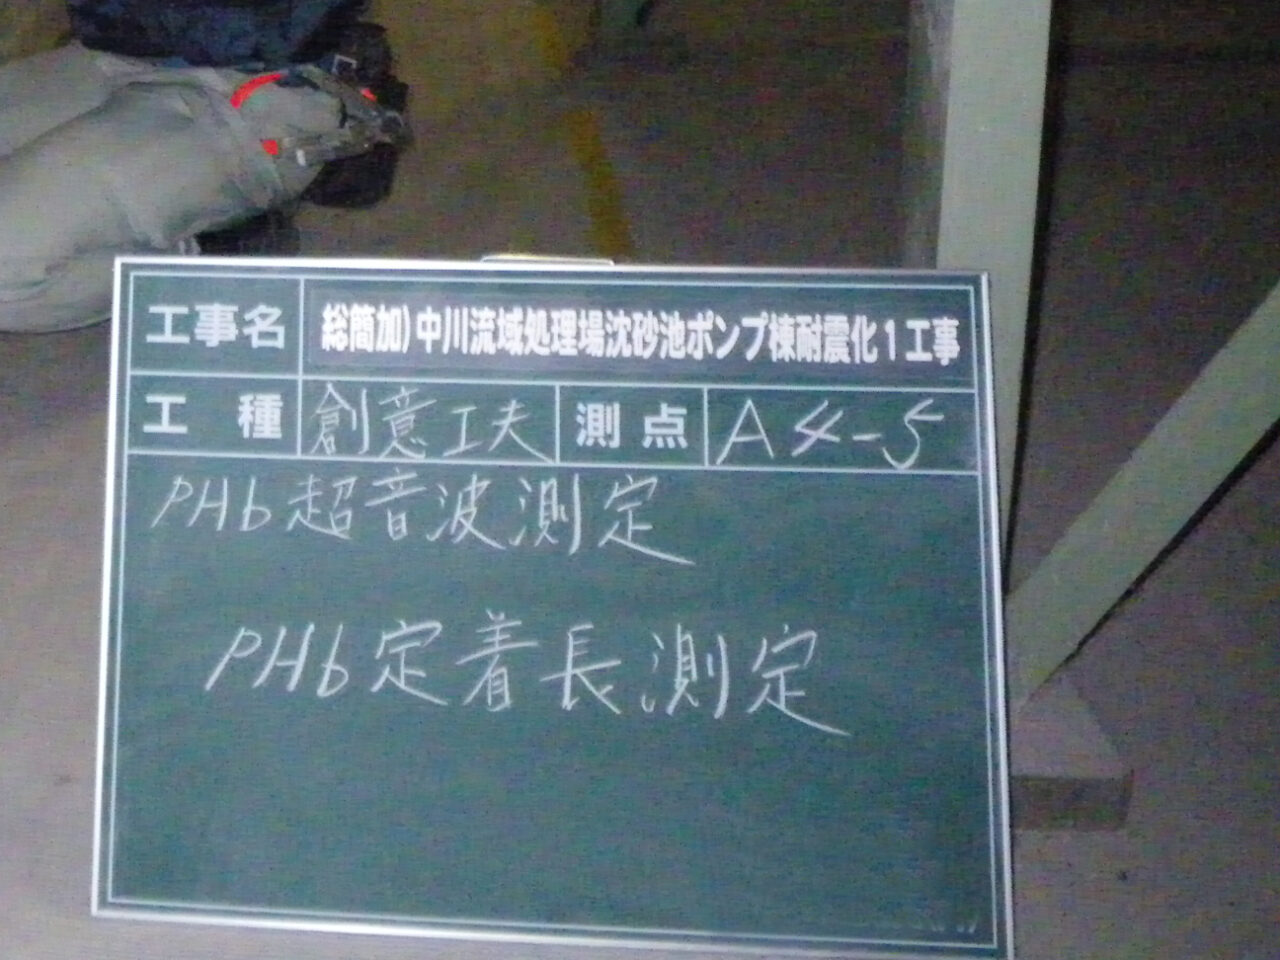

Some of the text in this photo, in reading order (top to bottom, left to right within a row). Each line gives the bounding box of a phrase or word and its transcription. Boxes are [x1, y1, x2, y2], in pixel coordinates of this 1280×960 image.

[145, 303, 285, 349] 工事名
[142, 393, 282, 439] 工種
[309, 382, 558, 464] 創意工夫
[575, 402, 688, 449] 測点
[715, 398, 945, 471] A4-5
